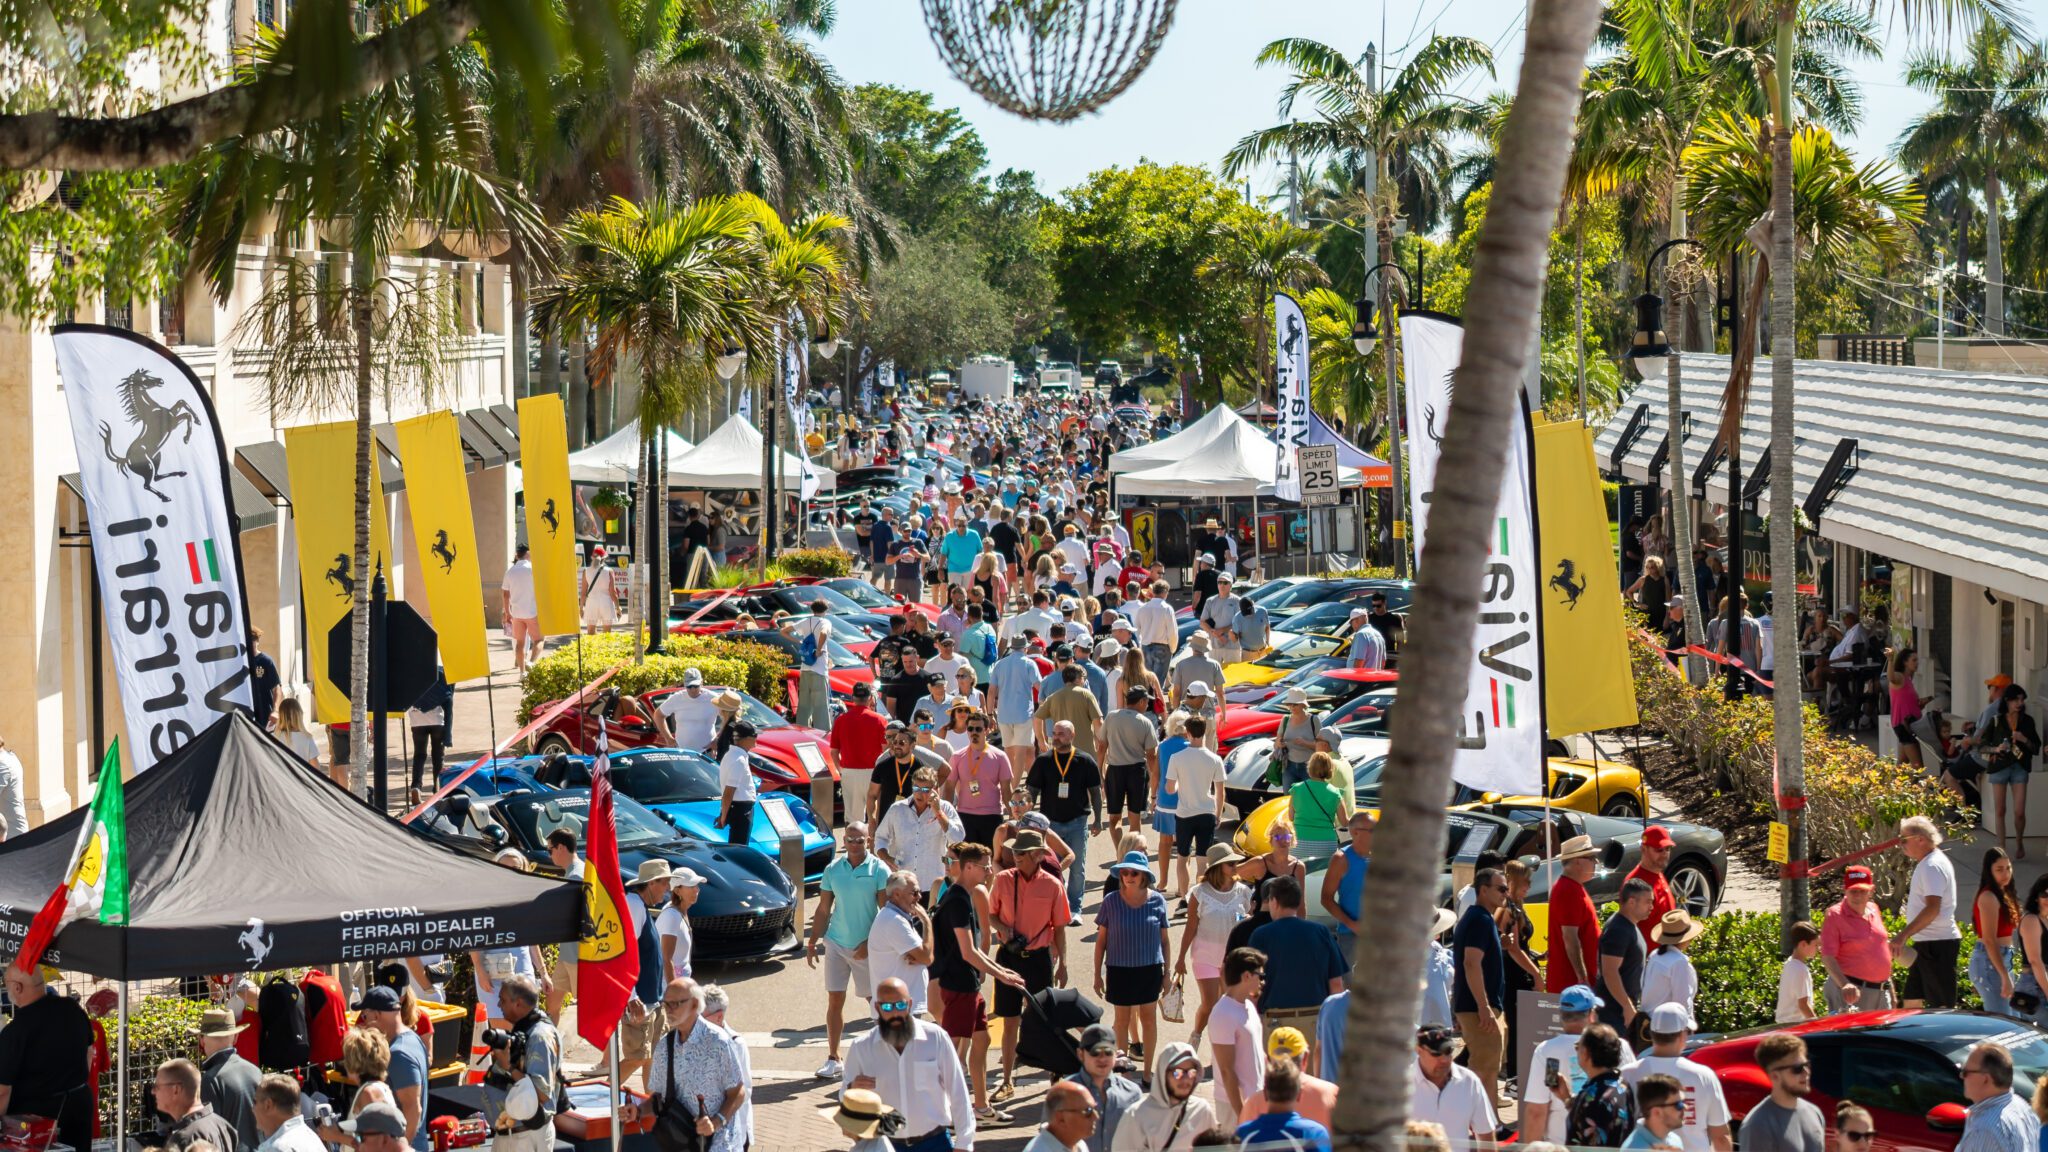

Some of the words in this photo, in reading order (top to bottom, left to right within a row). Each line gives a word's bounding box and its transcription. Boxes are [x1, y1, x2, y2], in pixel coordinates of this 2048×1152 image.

[1302, 450, 1333, 460] SPEED
[1306, 461, 1329, 469] LIMIT
[1304, 471, 1334, 489] 25
[1362, 473, 1389, 483] g.com
[1303, 496, 1313, 504] ALL
[340, 906, 425, 923] OFFICIAL
[10, 922, 30, 937] DEA
[342, 921, 420, 941] FERRARI
[425, 916, 495, 935] DEALER
[342, 939, 416, 959] FERRARI
[421, 937, 446, 951] OF
[448, 931, 516, 950] NAPLES
